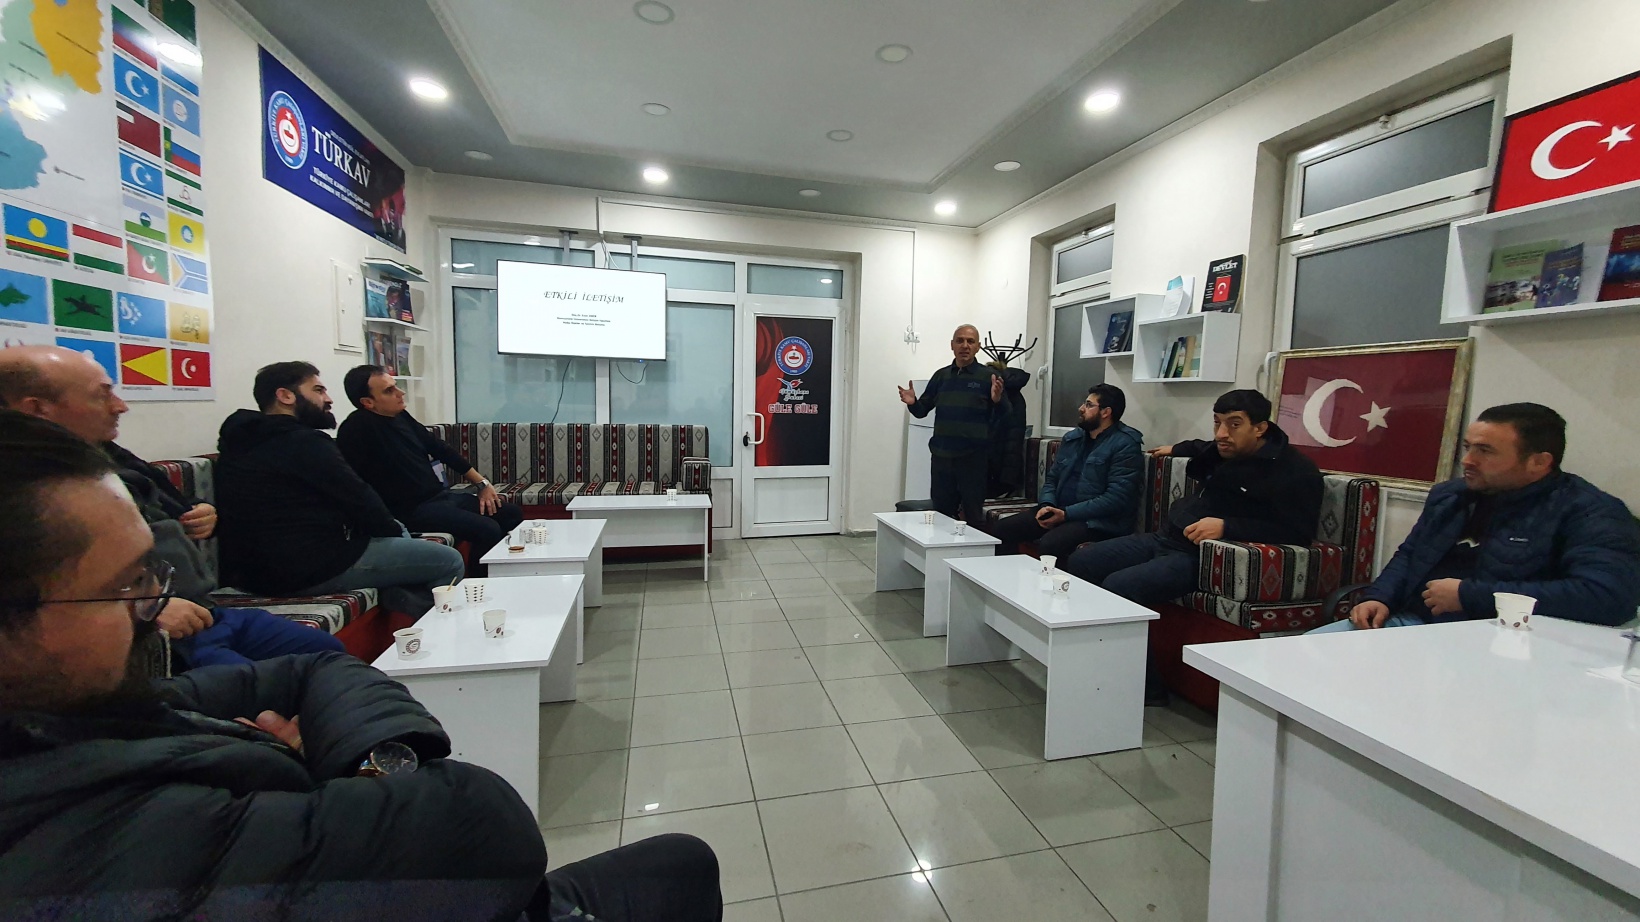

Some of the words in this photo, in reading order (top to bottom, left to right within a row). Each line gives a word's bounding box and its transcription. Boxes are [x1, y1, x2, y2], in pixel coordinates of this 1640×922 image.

[311, 125, 371, 188] TÜRKAV
[543, 291, 578, 301] ETKİLİ
[582, 292, 625, 304] İLETİŞİM
[767, 402, 793, 414] GÜLE
[794, 402, 819, 414] GÜLE
